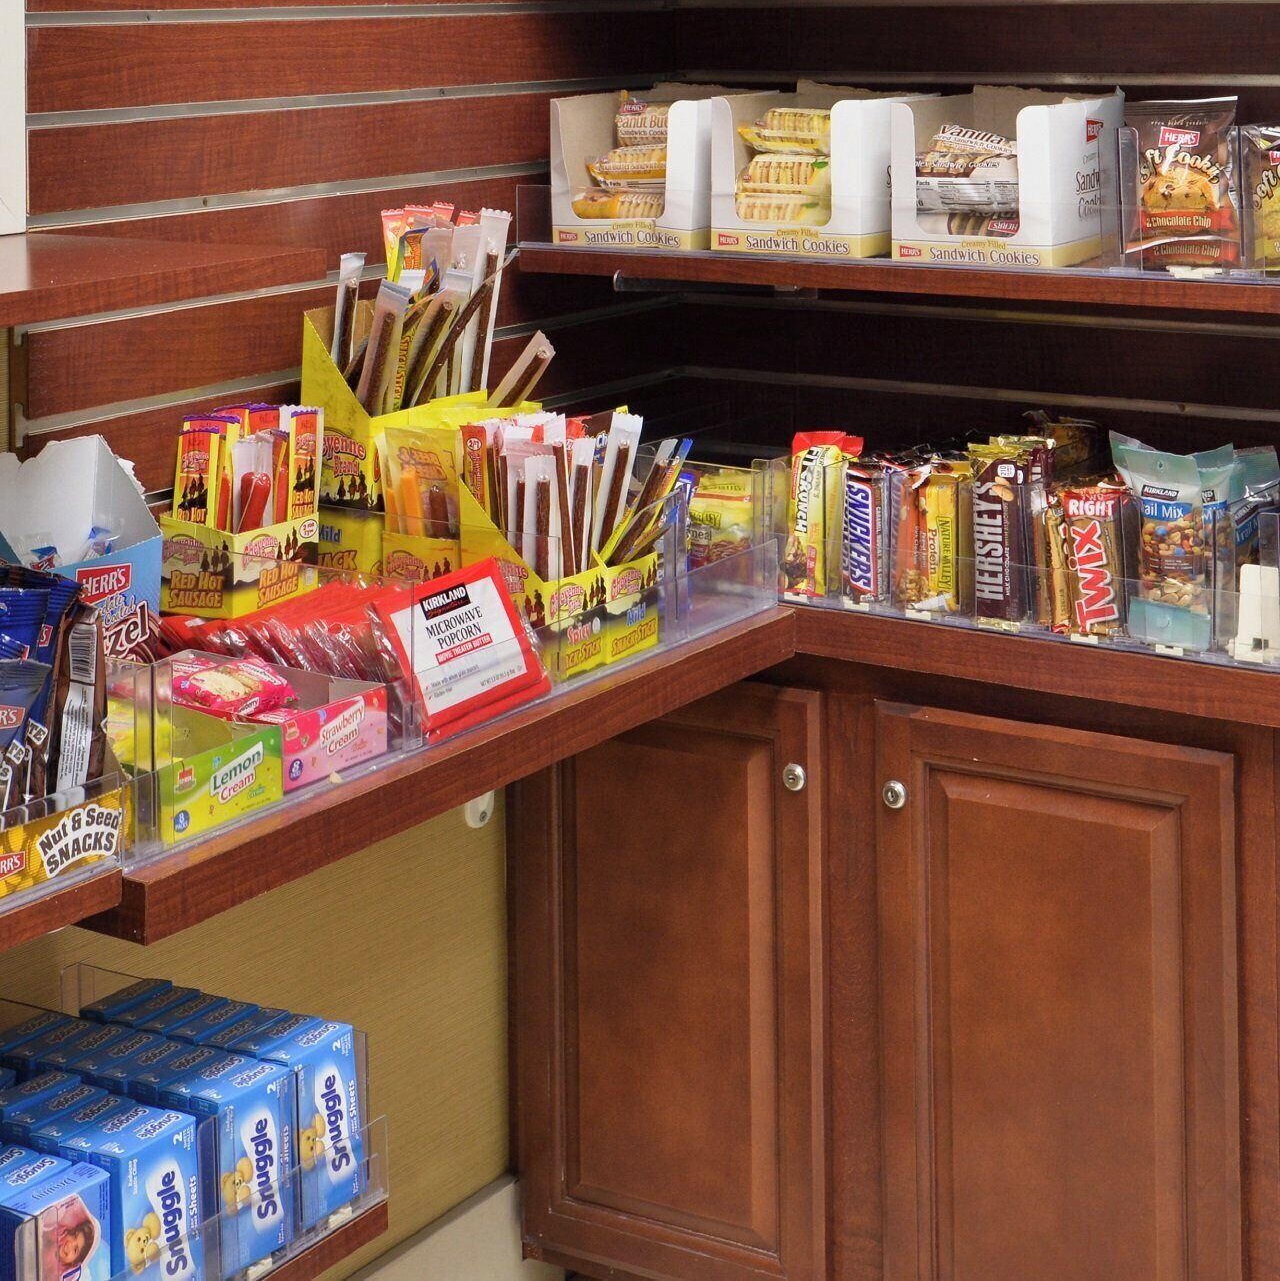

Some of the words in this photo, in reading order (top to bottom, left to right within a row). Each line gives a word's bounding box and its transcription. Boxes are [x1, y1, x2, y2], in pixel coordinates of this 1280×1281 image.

[938, 125, 1006, 145] Vanilla
[583, 229, 634, 246] Sandwich
[637, 231, 681, 248] Cookies
[745, 235, 797, 252] Sandwich
[801, 238, 850, 255] Cookies
[928, 248, 984, 264] Sandwich
[988, 251, 1041, 266] Cookies
[1067, 499, 1114, 518] RIGHT
[1143, 486, 1177, 498] KIRKLAND
[846, 481, 872, 592] SNICKERS
[973, 481, 1005, 601] HERSHEY'S
[422, 587, 466, 611] KIRKLAND
[426, 606, 483, 639] MICROWAVE
[437, 621, 482, 650] POPCORN
[320, 697, 366, 746] Strawberry
[211, 742, 264, 792] Lemon
[46, 834, 118, 874] SNACKS
[321, 1074, 350, 1171] Snuggle
[251, 1116, 277, 1220] Snuggle
[157, 1170, 187, 1276] Snuggle
